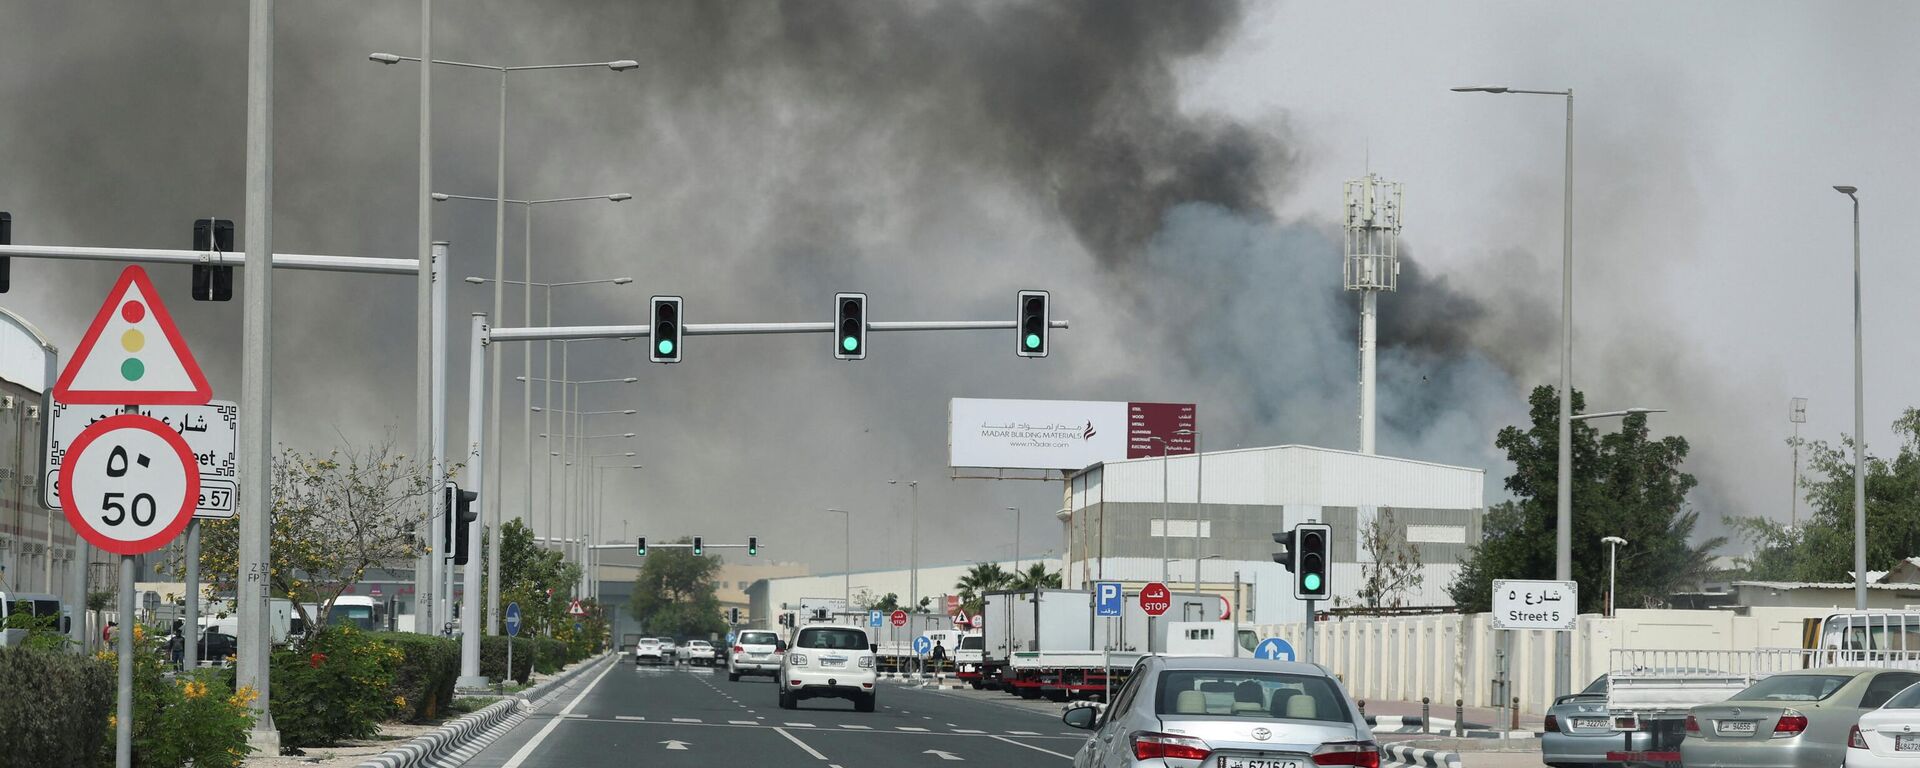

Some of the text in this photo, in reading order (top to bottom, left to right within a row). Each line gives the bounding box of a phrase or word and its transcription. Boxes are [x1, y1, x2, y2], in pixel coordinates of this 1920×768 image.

[981, 430, 1082, 440] MADAR BUILDING MATERIALS
[1010, 440, 1069, 448] www.madar.com
[107, 445, 151, 478] ٥٠
[193, 450, 216, 466] eet
[211, 491, 230, 508] 57
[101, 492, 157, 527] 50
[261, 563, 269, 572] 57
[248, 573, 260, 583] FP
[1101, 585, 1117, 606] P
[1146, 588, 1164, 598] قف
[1508, 590, 1561, 605] شارع ٥
[1144, 602, 1168, 611] STOP
[872, 611, 880, 622] P
[1509, 610, 1560, 621] Street 5
